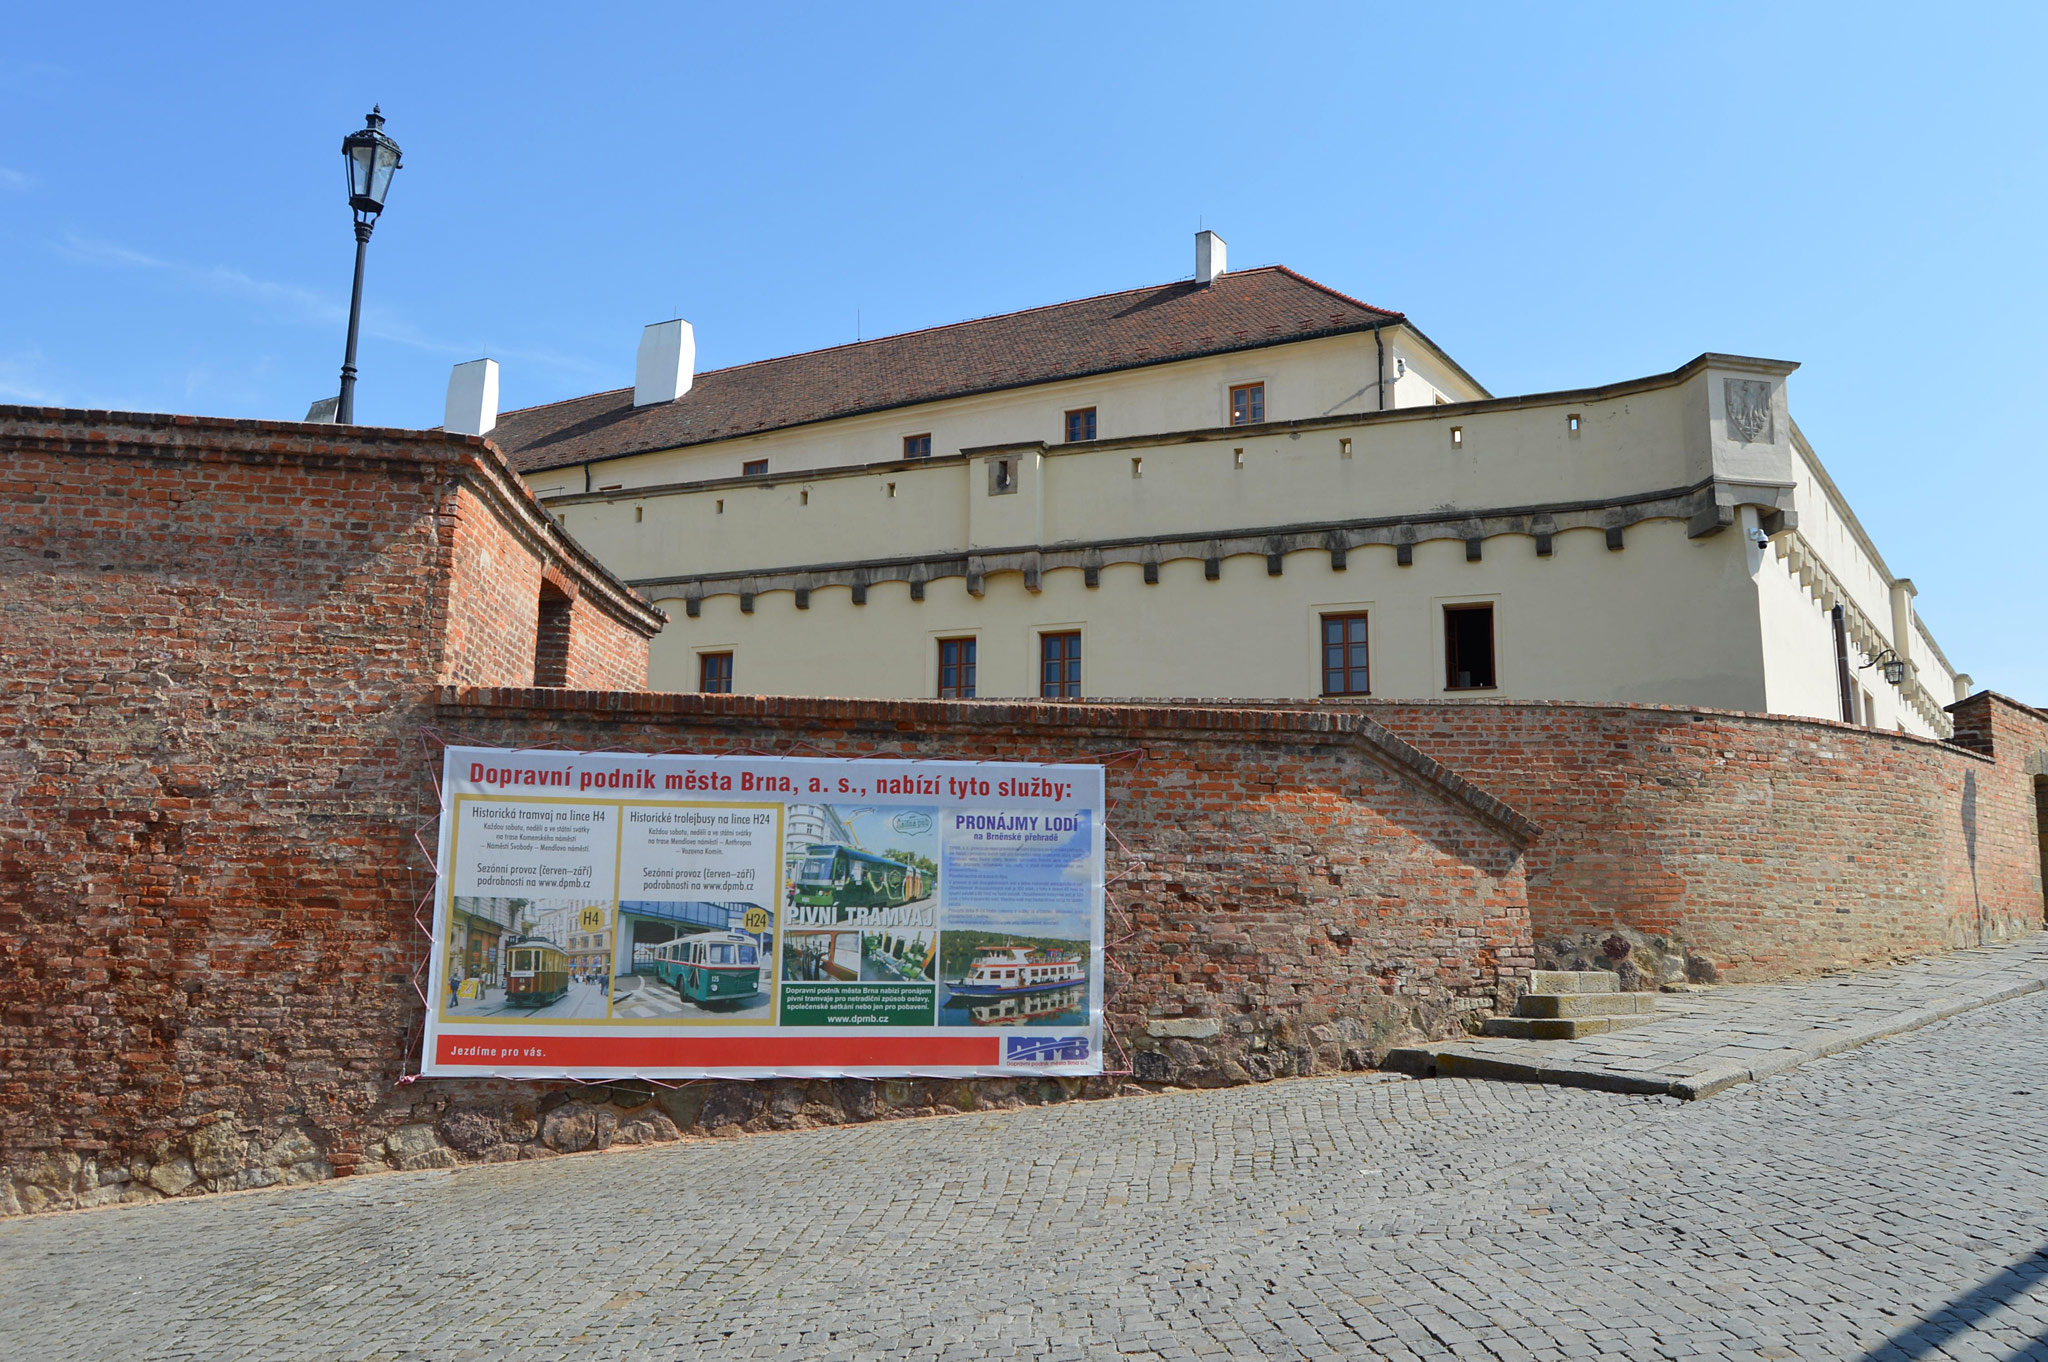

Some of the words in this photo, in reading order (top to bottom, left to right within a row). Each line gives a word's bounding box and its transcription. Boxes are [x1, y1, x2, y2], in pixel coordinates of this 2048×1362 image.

[470, 762, 574, 788] Dopravní
[580, 769, 656, 791] podnik
[665, 770, 732, 791] města
[741, 771, 798, 796] Brna,
[809, 778, 828, 793] a.
[838, 779, 866, 797] s.,
[876, 775, 941, 795] nabízí
[949, 777, 990, 800] tyto
[998, 778, 1072, 801] služby:
[472, 807, 515, 818] Historická
[519, 810, 553, 822] tramvaj
[570, 810, 589, 821] lince
[593, 812, 605, 821] H4
[631, 812, 671, 823] Historické
[674, 812, 715, 826] trolejbusy
[731, 813, 750, 824] lince
[753, 814, 770, 824] H24
[956, 812, 1038, 830] PRONÁJMY
[1045, 814, 1079, 831] LODÍ
[1025, 833, 1058, 842] přehradě
[477, 863, 508, 873] Sezónní
[510, 866, 536, 875] provoz
[643, 868, 673, 878] Sezónní
[675, 871, 701, 879] provoz
[477, 876, 524, 887] podrobnosti
[539, 879, 590, 889] www.dpmb.cz
[644, 880, 688, 891] podrobnosti
[703, 882, 753, 892] www.dpmb.cz
[583, 912, 599, 925] H4
[746, 914, 766, 927] H24
[787, 902, 839, 925] PIVNÍ
[845, 907, 934, 926] TRAMVAJ
[828, 1015, 888, 1024] www.dpmb.cz
[451, 1046, 497, 1056] Jezdíme
[502, 1049, 519, 1058] pro
[524, 1047, 546, 1056] vás.
